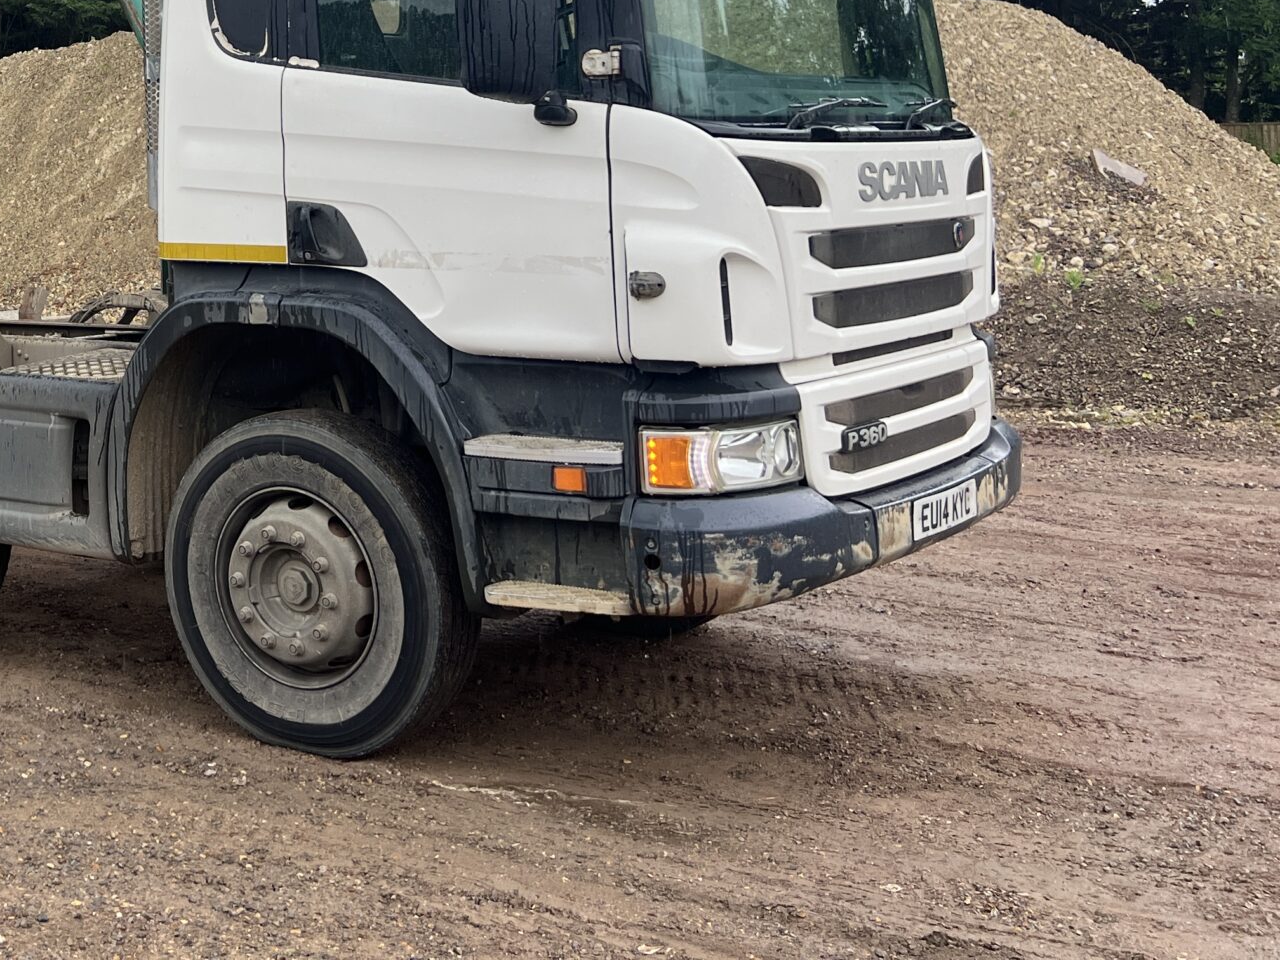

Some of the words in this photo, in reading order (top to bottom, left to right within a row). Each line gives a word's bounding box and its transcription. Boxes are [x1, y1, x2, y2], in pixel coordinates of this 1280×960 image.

[858, 160, 949, 202] SCANIA
[922, 497, 949, 532] EU14
[952, 487, 971, 521] KYC
